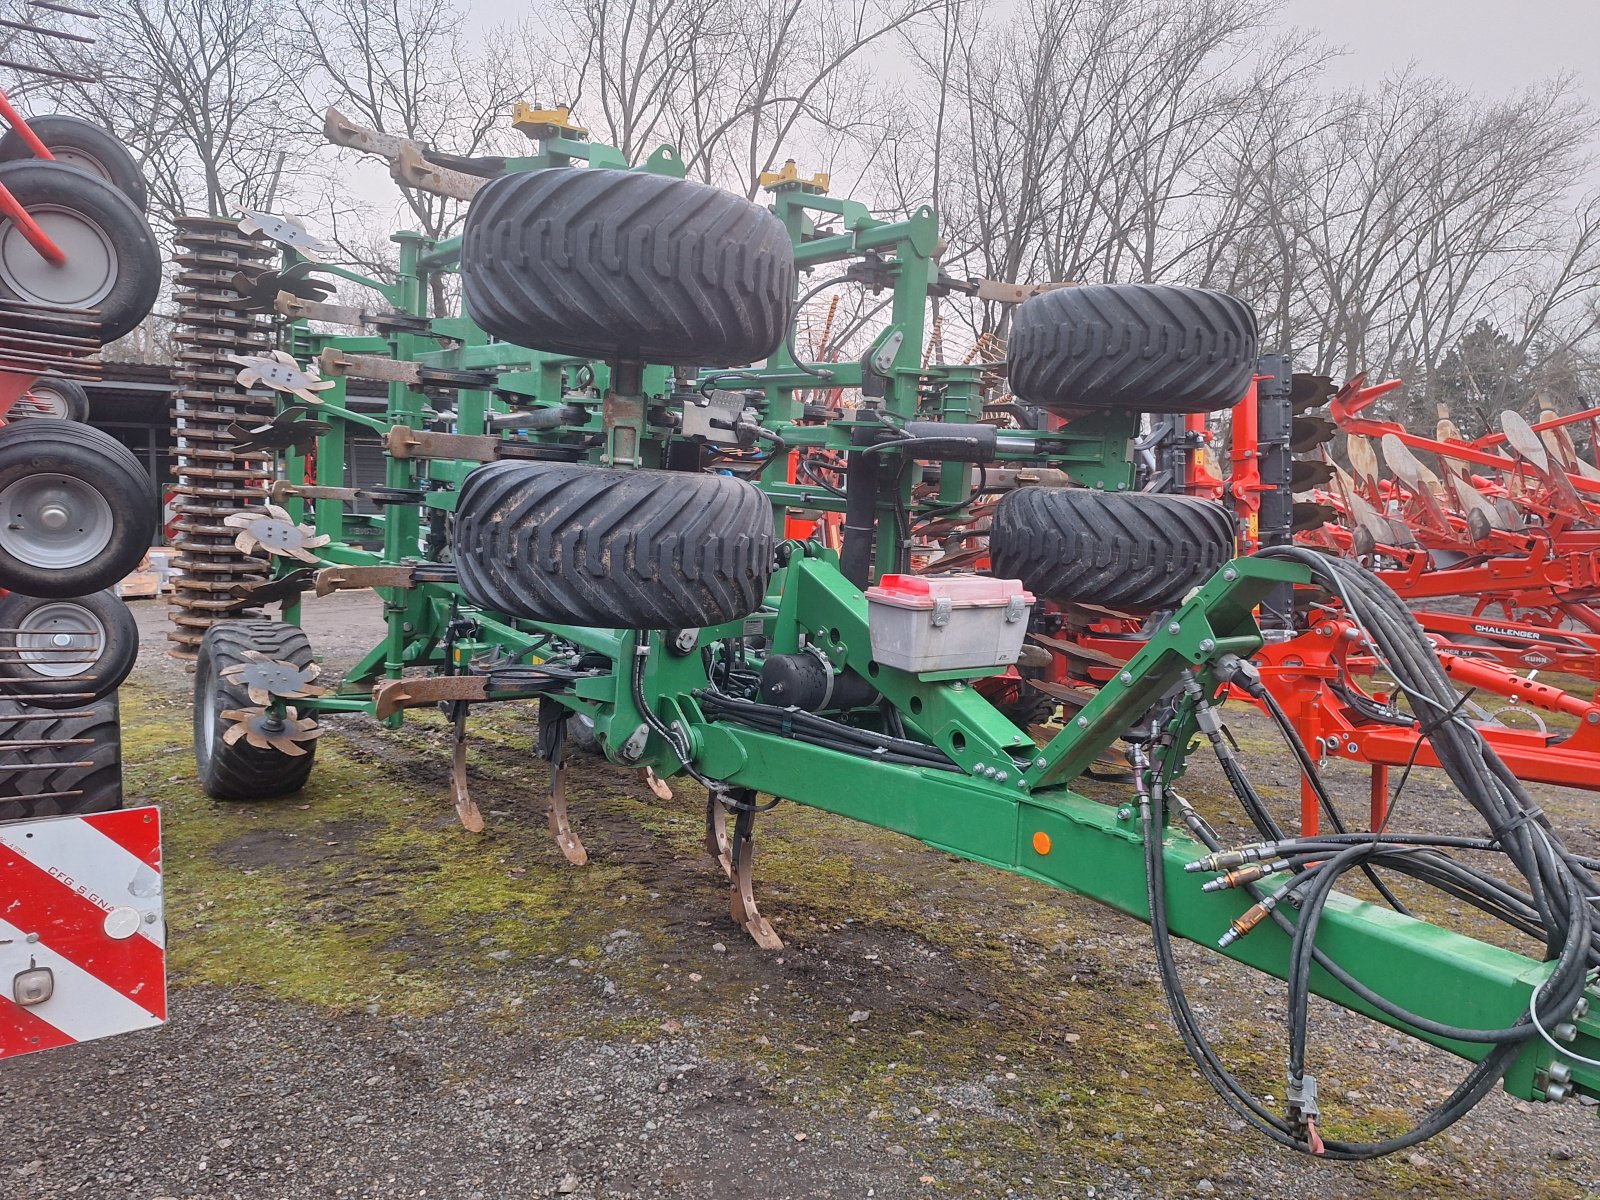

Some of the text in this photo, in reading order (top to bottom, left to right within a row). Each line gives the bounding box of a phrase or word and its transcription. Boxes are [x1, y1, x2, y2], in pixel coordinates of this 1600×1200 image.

[1475, 624, 1540, 640] CHALLENGER
[1439, 648, 1460, 657] ADER
[1524, 655, 1547, 664] KUHN
[47, 866, 115, 913] CFG SGNA
